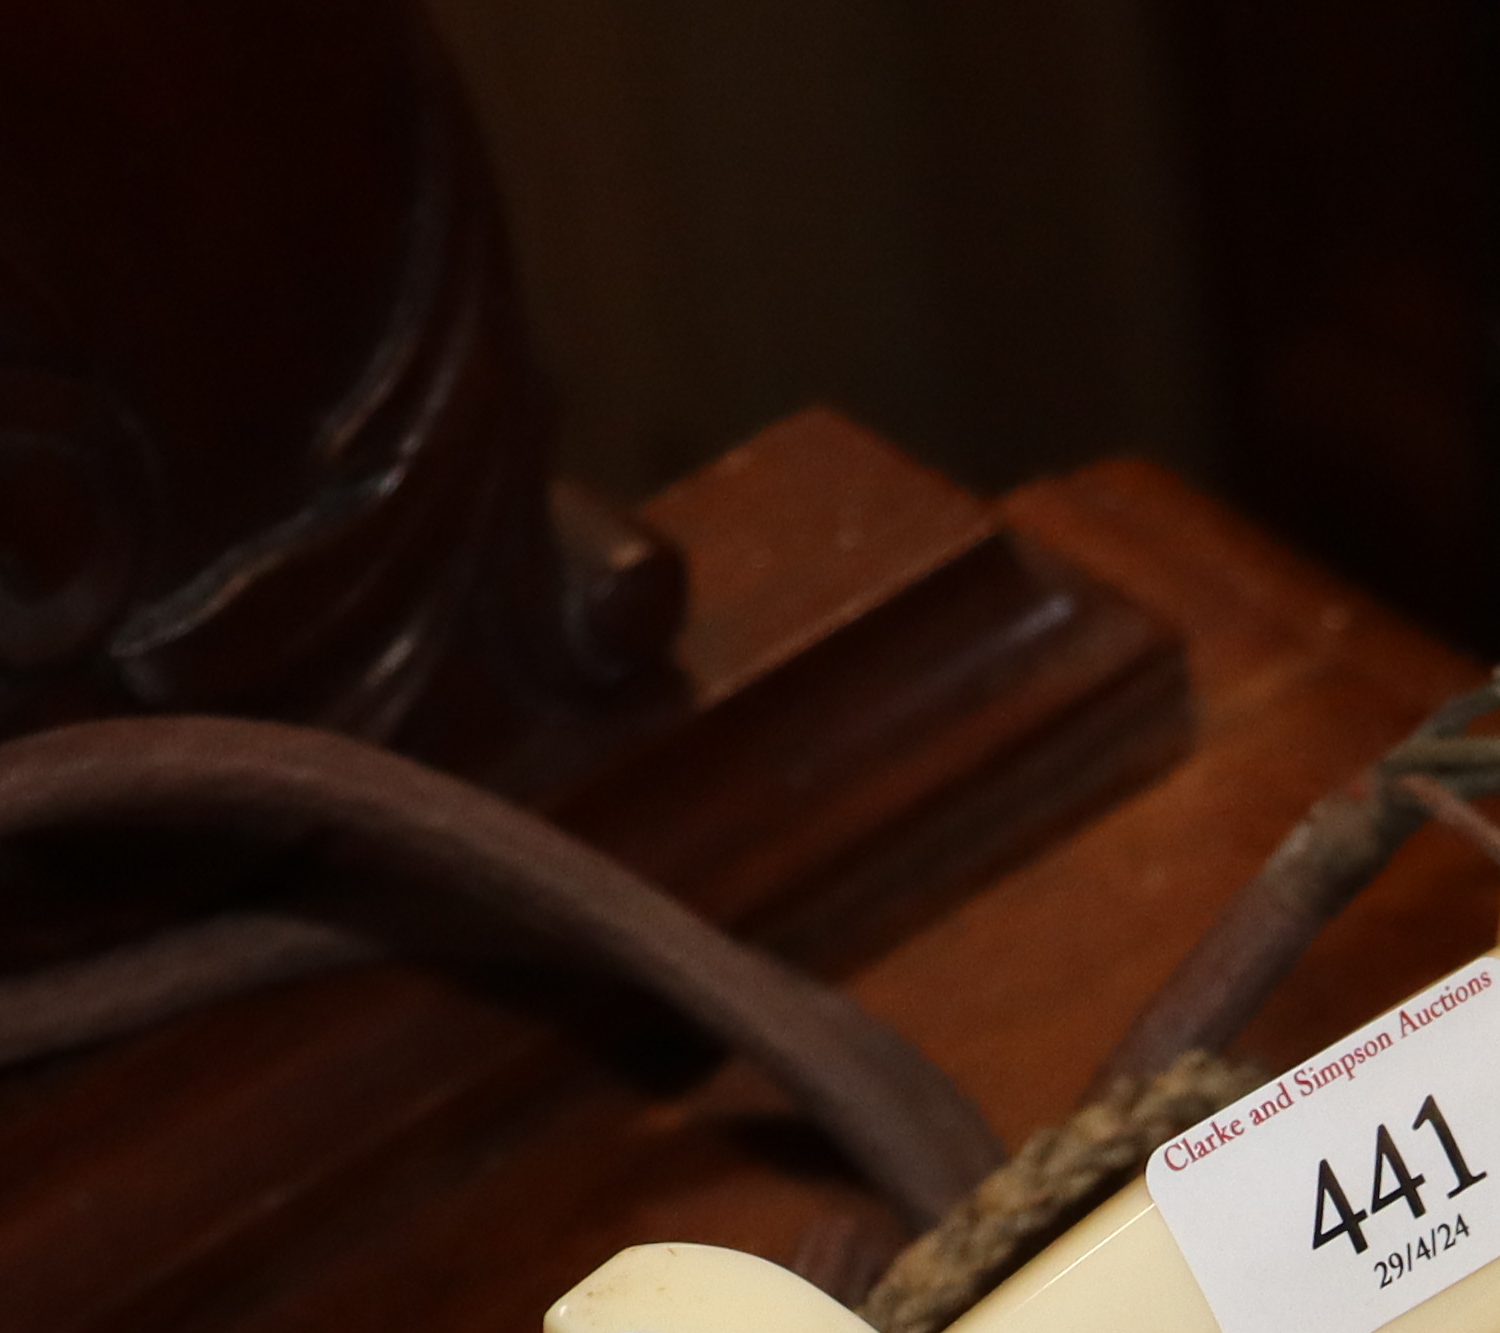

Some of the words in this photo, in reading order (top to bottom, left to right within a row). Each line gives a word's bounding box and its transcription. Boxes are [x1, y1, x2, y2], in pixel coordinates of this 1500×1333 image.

[1163, 1117, 1246, 1173] Clarke
[1248, 1082, 1295, 1127] and
[1293, 1032, 1394, 1098] Simpson
[1398, 969, 1494, 1039] Auctions
[1311, 1093, 1488, 1255] 441
[1372, 1212, 1472, 1290] 29/4/24
